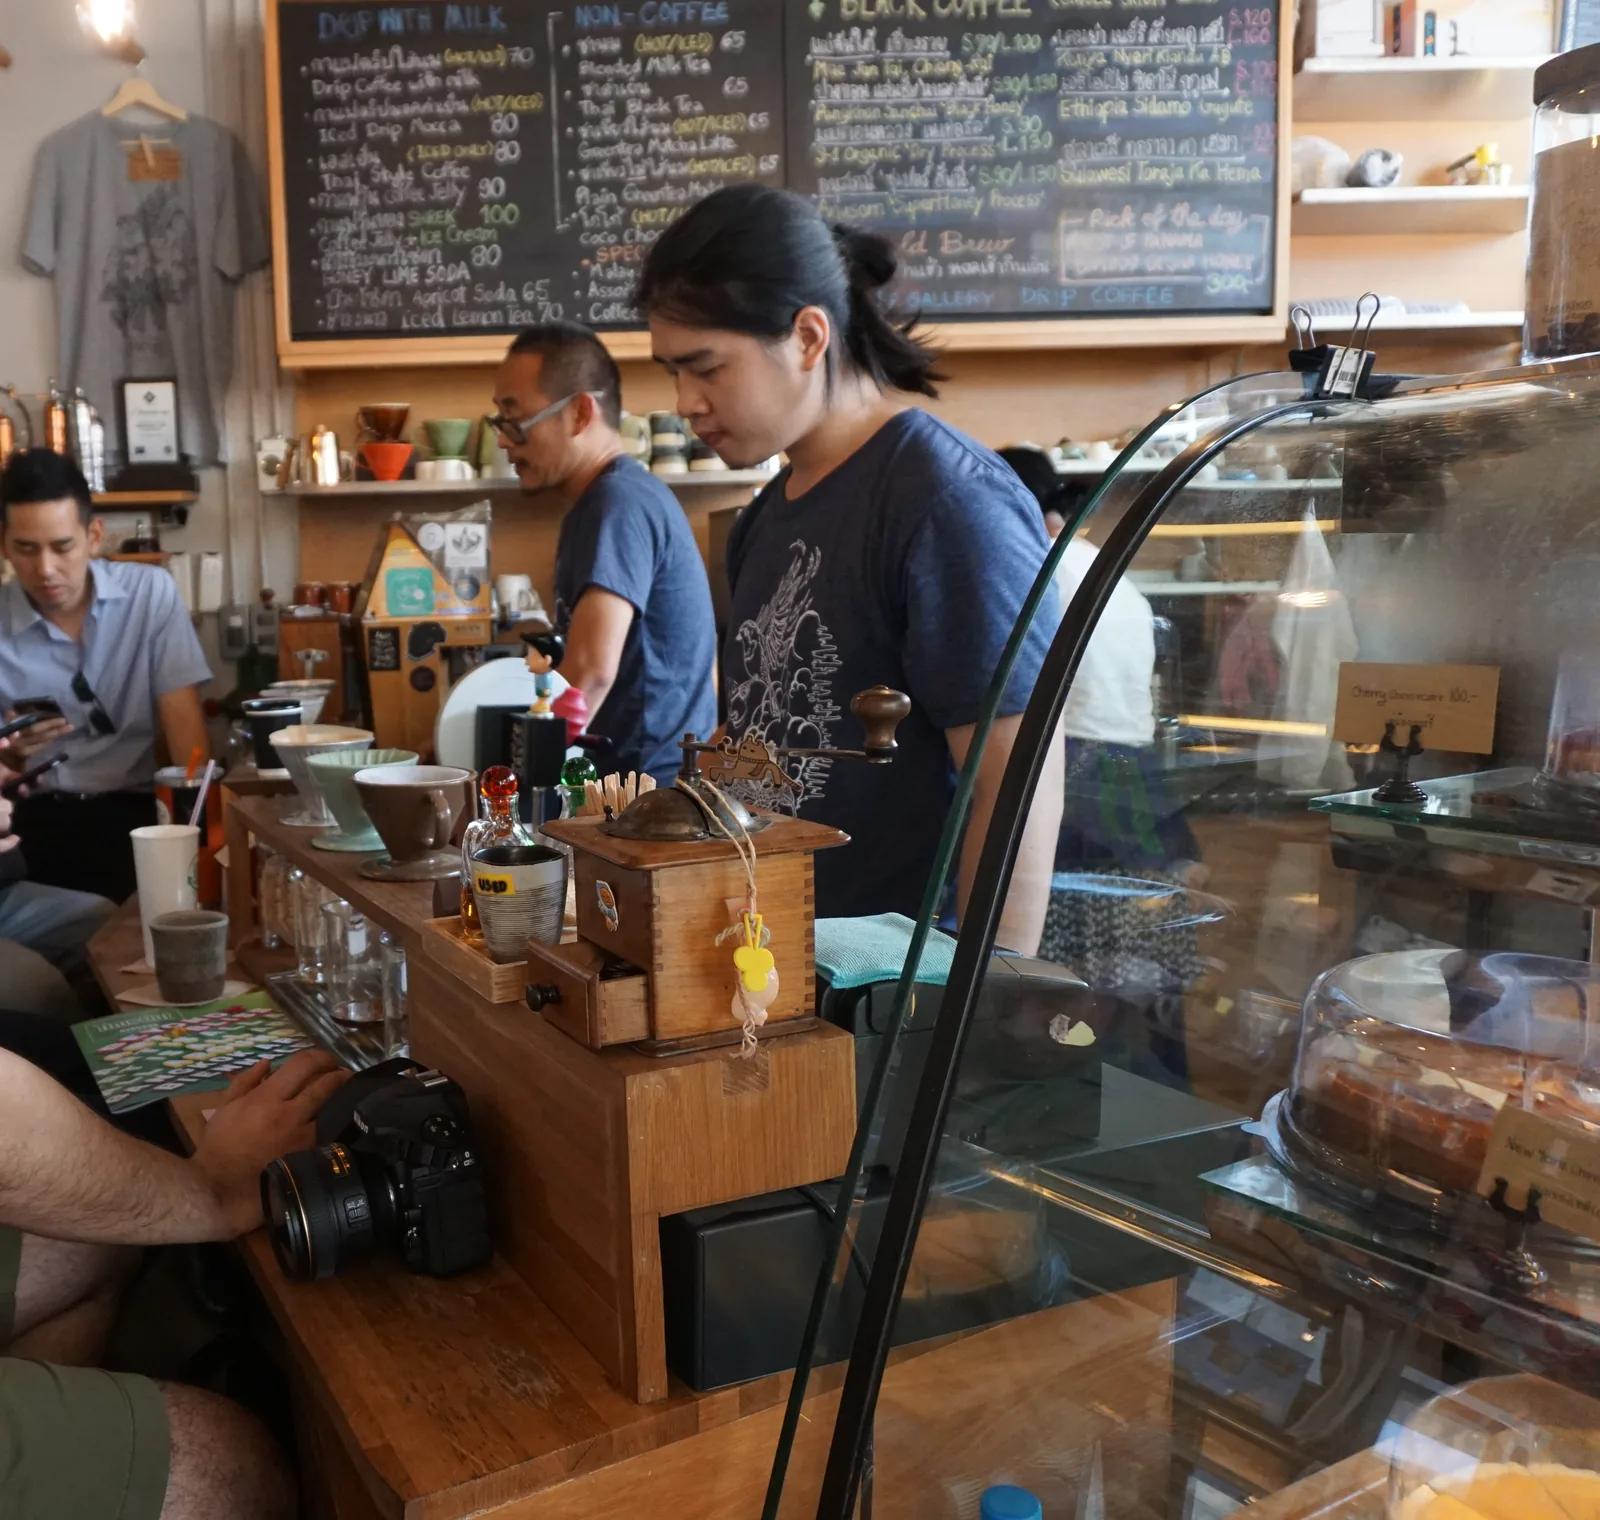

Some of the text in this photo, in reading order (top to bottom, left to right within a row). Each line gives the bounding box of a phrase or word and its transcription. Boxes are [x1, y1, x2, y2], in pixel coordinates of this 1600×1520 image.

[378, 7, 433, 33] WITH
[445, 5, 507, 31] MILK
[720, 30, 747, 52] 65
[509, 46, 536, 69] 70
[311, 79, 351, 99] Drip
[355, 74, 402, 93] Coffee
[723, 76, 750, 98] 65
[1059, 97, 1129, 125] Ethiopia
[1133, 96, 1192, 117] Sidamo
[366, 123, 403, 143] Drip
[748, 112, 771, 133] 65
[494, 140, 522, 164] 80
[422, 160, 470, 180] Coffee
[758, 154, 780, 173] 65
[478, 176, 506, 199] 90
[479, 203, 520, 225] 100
[446, 226, 498, 243] Cream
[470, 244, 502, 267] 80
[382, 264, 420, 285] LIME
[425, 261, 471, 282] SODA
[473, 281, 516, 302] Soda
[522, 279, 551, 300] 65
[1021, 285, 1077, 307] DRIP
[1092, 285, 1175, 305] COFFEE
[452, 303, 505, 326] Lemon
[507, 305, 535, 326] Tea
[537, 302, 563, 322] 70
[1352, 685, 1388, 706] Cherry
[478, 878, 508, 893] USED
[353, 1110, 369, 1134] Nikon
